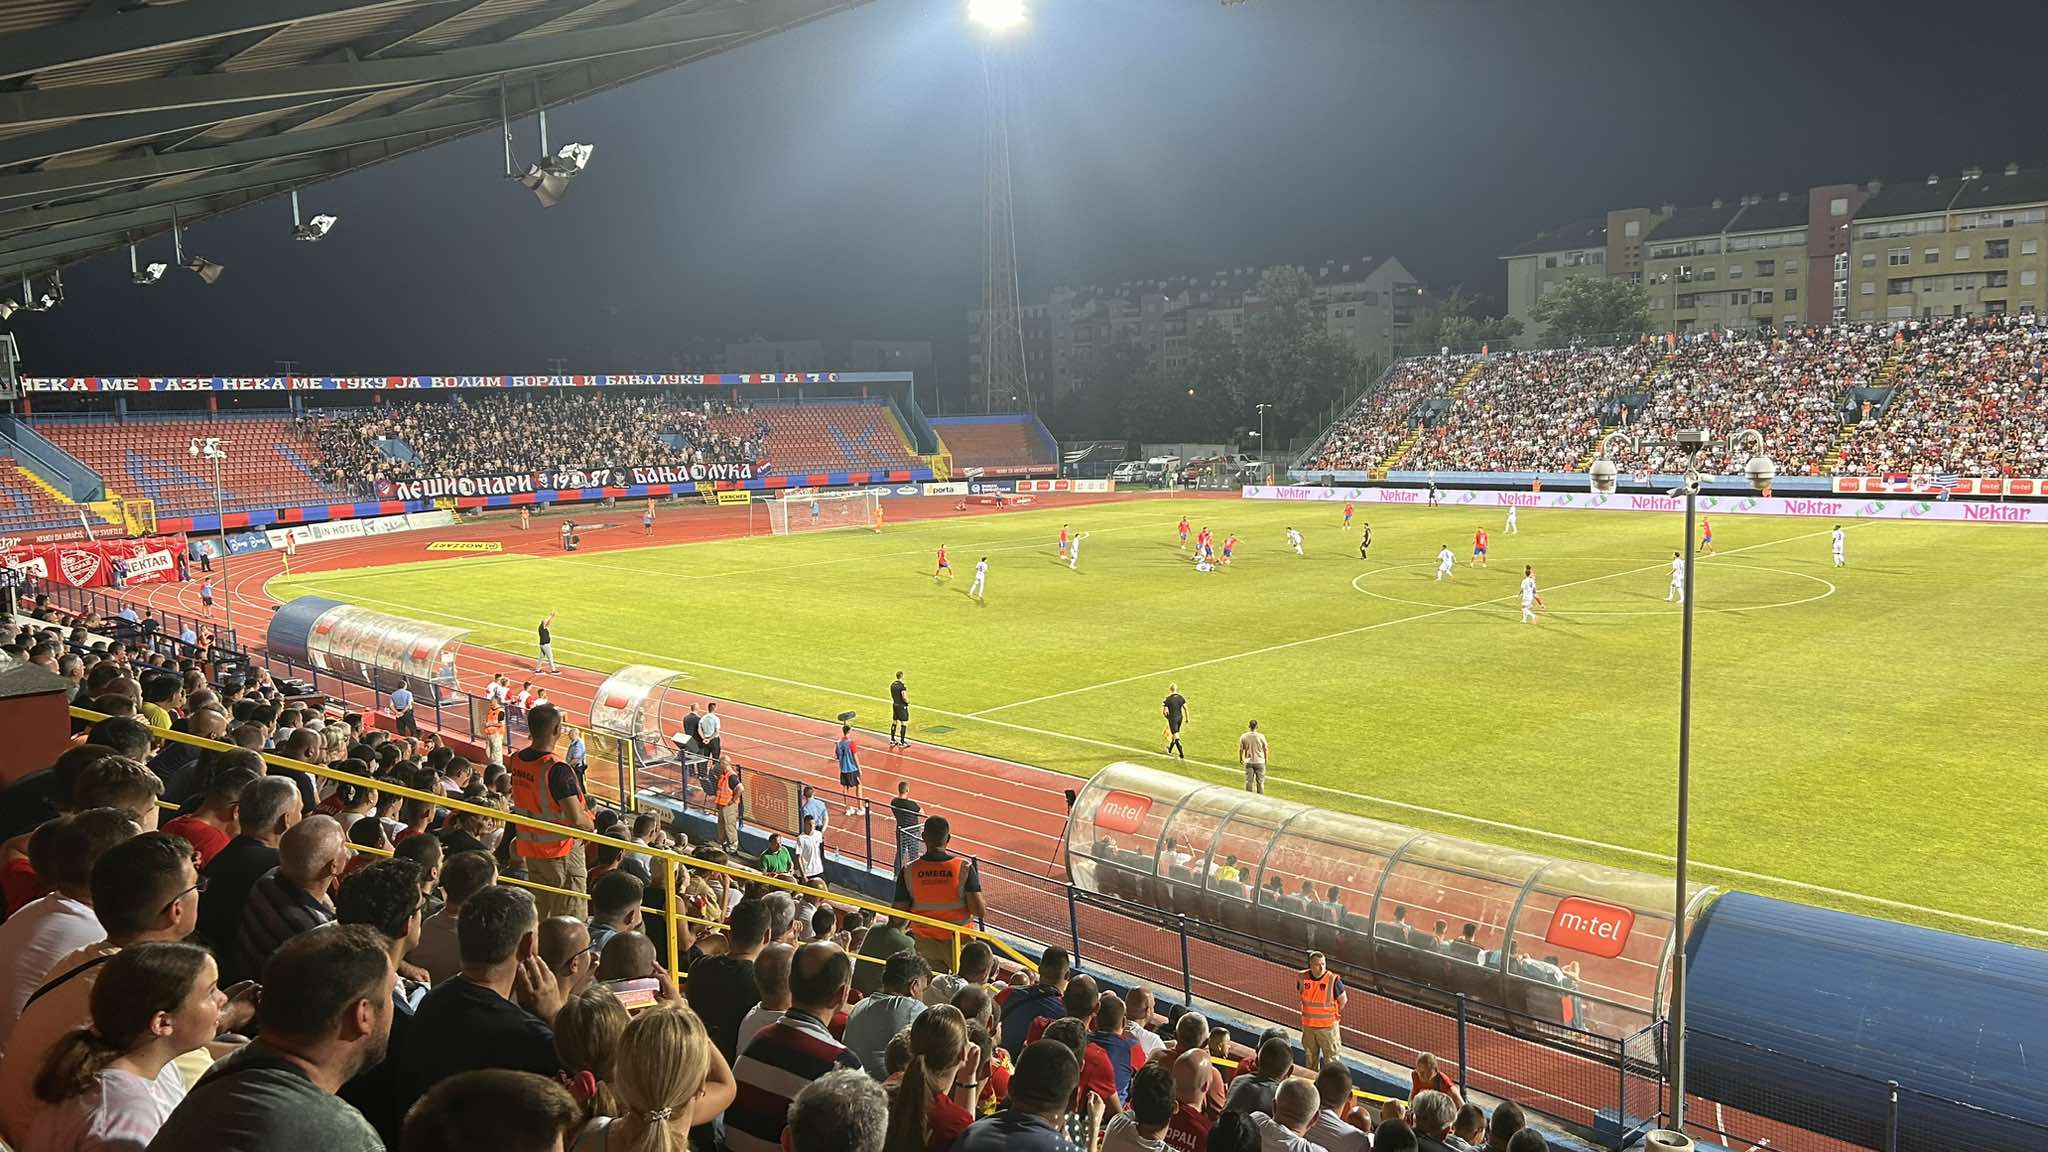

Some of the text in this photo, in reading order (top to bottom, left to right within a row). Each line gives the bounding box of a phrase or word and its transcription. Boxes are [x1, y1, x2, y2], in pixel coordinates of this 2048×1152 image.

[22, 377, 88, 391] НЕКА
[101, 378, 139, 391] МЕ
[151, 378, 213, 391] ГАЗЕ
[222, 378, 285, 390] НЕКА
[292, 378, 323, 390] МЕ
[331, 378, 387, 390] ТУКУ
[431, 376, 501, 388] ВОЛИМ
[511, 376, 576, 387] БОРАЦ
[584, 376, 596, 386] И
[605, 374, 704, 386] БАЊАЛУКУ
[933, 486, 954, 495] porta
[1276, 487, 1310, 499] Nektar
[1380, 489, 1418, 503] Nektar
[1497, 493, 1541, 506] Nektar
[1631, 496, 1681, 510] Nektar
[1785, 500, 1841, 515] Nektar
[1963, 504, 2031, 521] Nektar
[333, 524, 361, 534] HOTEL
[1104, 802, 1143, 820] m:tel
[1560, 913, 1621, 940] m:tel
[1166, 1128, 1197, 1149] ОРАЦ
